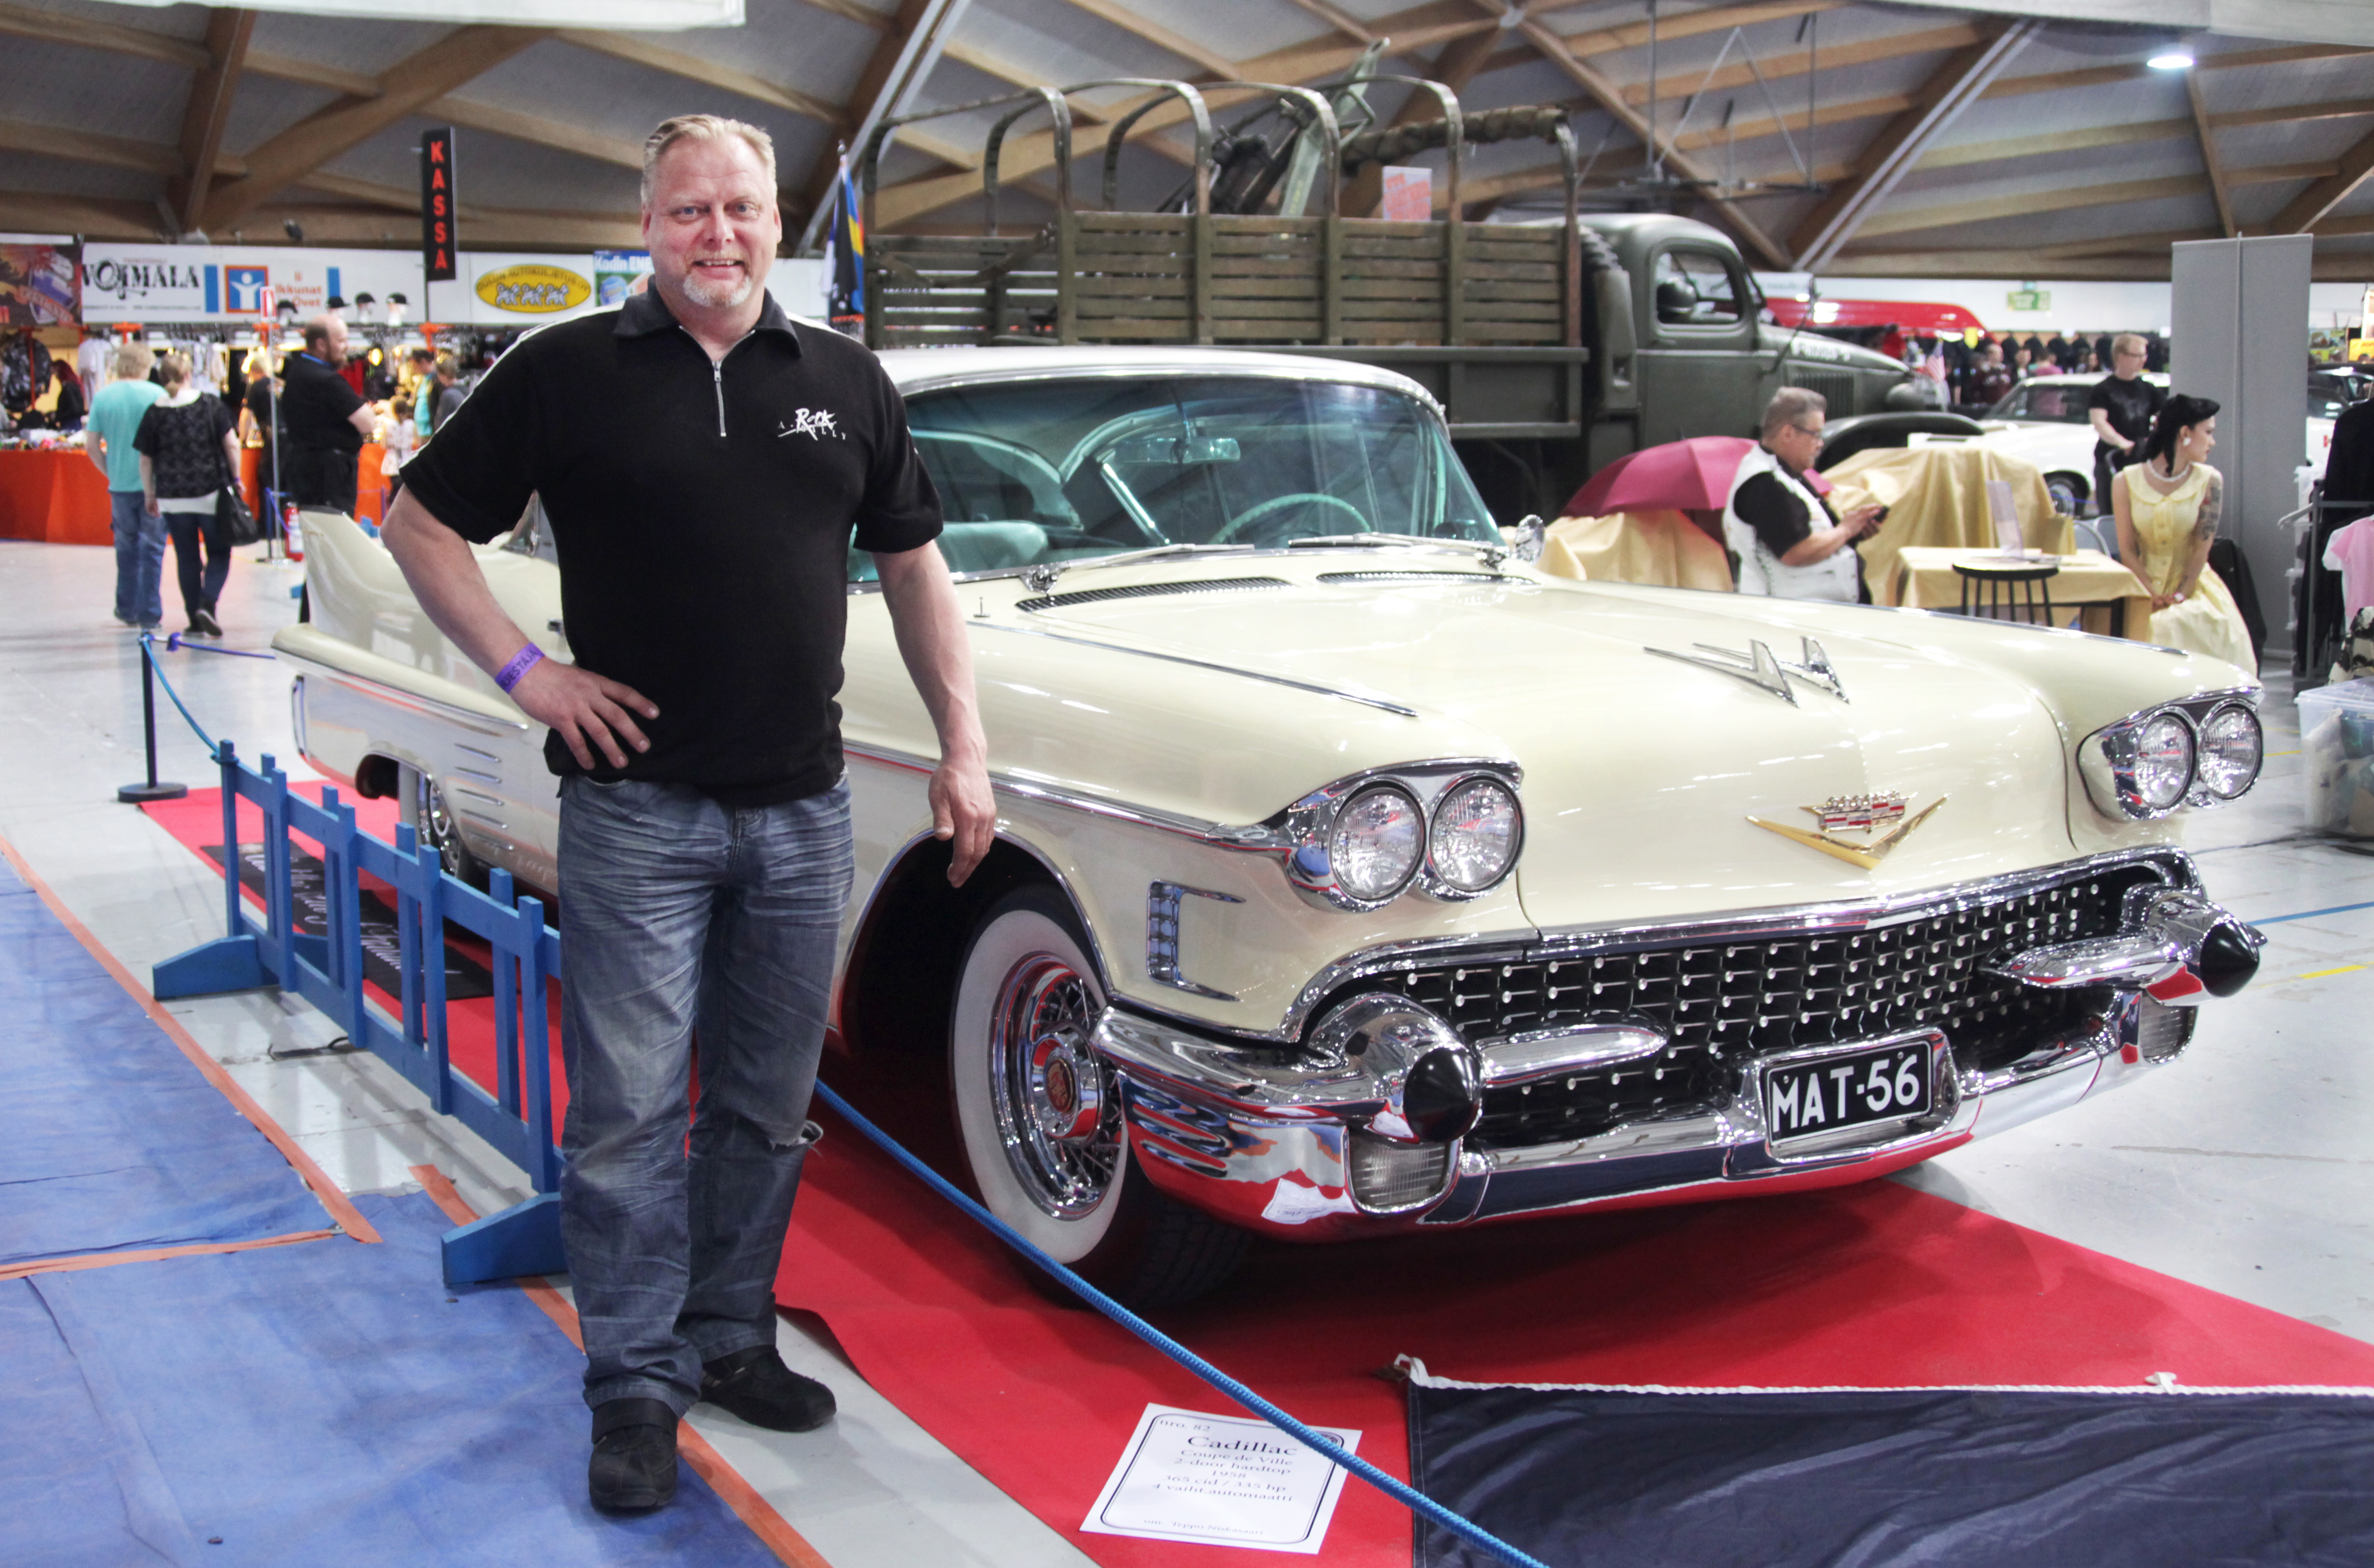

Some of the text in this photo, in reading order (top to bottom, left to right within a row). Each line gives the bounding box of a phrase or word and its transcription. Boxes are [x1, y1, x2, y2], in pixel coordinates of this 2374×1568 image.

[430, 140, 448, 269] KASSA
[593, 256, 627, 271] Kodin
[275, 284, 322, 294] Ikkunat
[292, 296, 320, 307] Ovet
[1772, 1053, 1919, 1133] MAT-56
[1160, 1419, 1187, 1429] nro.
[1187, 1436, 1297, 1456] Cadillac
[1181, 1449, 1231, 1459] Coupe
[1260, 1456, 1293, 1466] Ville
[1174, 1458, 1291, 1475] 2-door hardtop
[1212, 1470, 1247, 1479] 1958
[1167, 1486, 1293, 1501] vaiht.automaatti
[1233, 1481, 1261, 1489] 335
[1267, 1484, 1286, 1493] hp
